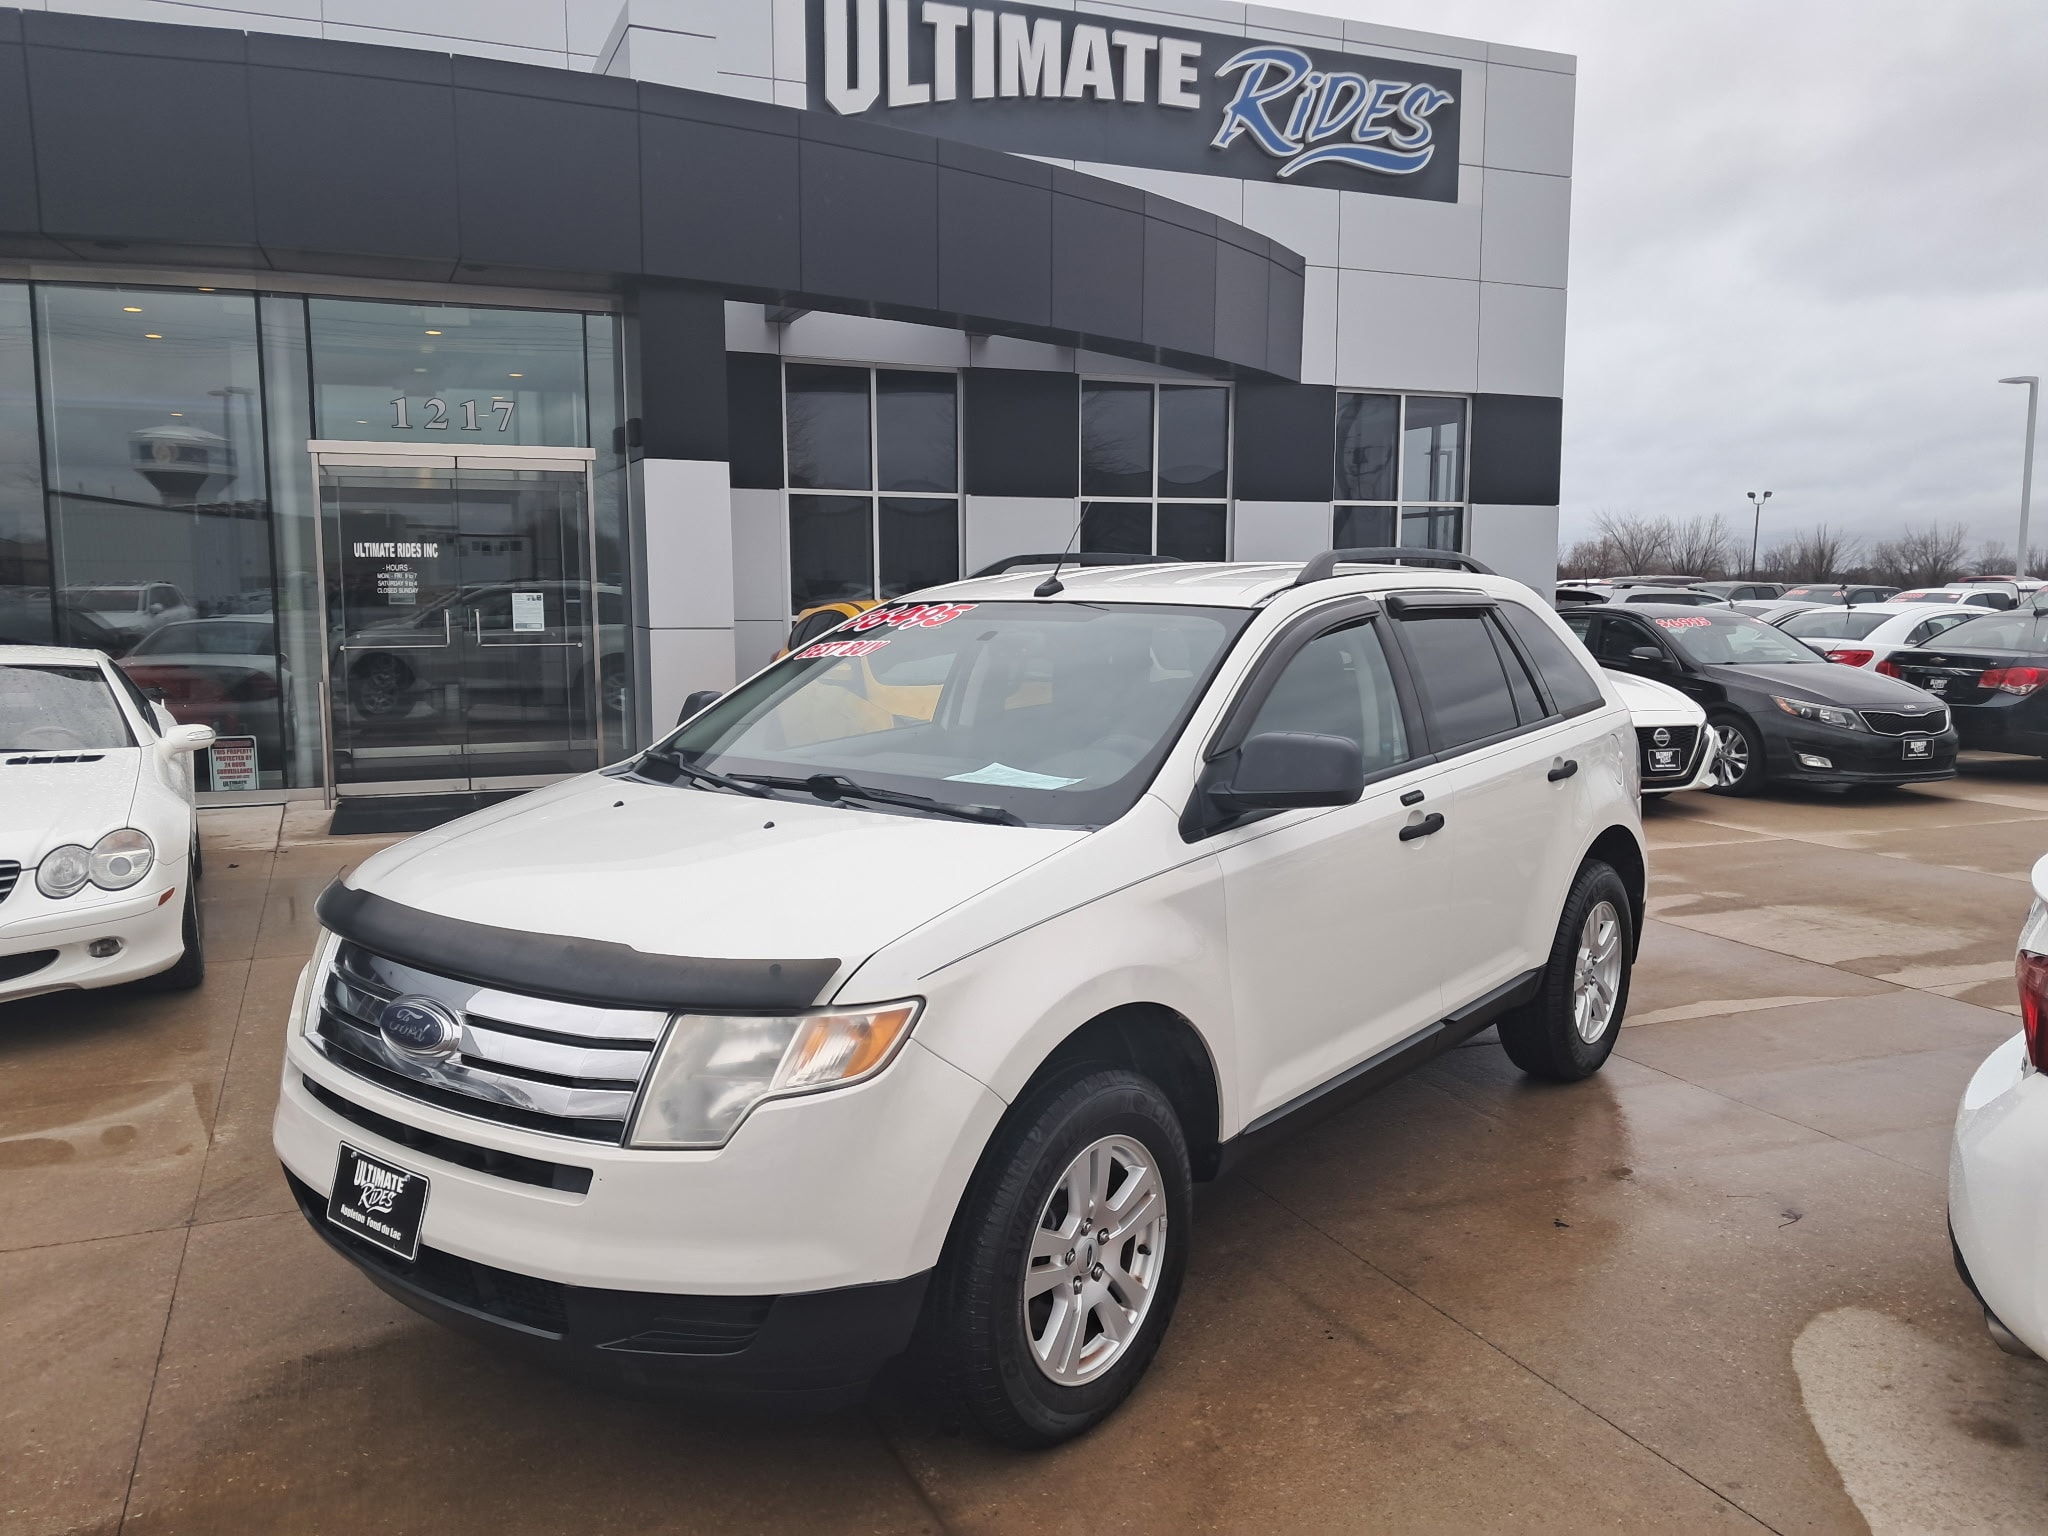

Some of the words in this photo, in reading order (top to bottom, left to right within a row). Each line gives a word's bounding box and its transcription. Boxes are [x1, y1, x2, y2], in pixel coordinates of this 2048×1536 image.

[823, 0, 1202, 115] ULTIMATE
[390, 396, 516, 432] 1217
[353, 542, 396, 558] ULTIMATE
[396, 542, 422, 558] RIDES
[423, 542, 439, 558] INC
[840, 640, 892, 657] BUY
[389, 1008, 431, 1042] Ford
[353, 1159, 406, 1194] ULTIMATE
[340, 1203, 366, 1224] Appleton
[366, 1216, 382, 1232] Fond
[381, 1223, 390, 1236] du
[389, 1227, 402, 1241] Lac
